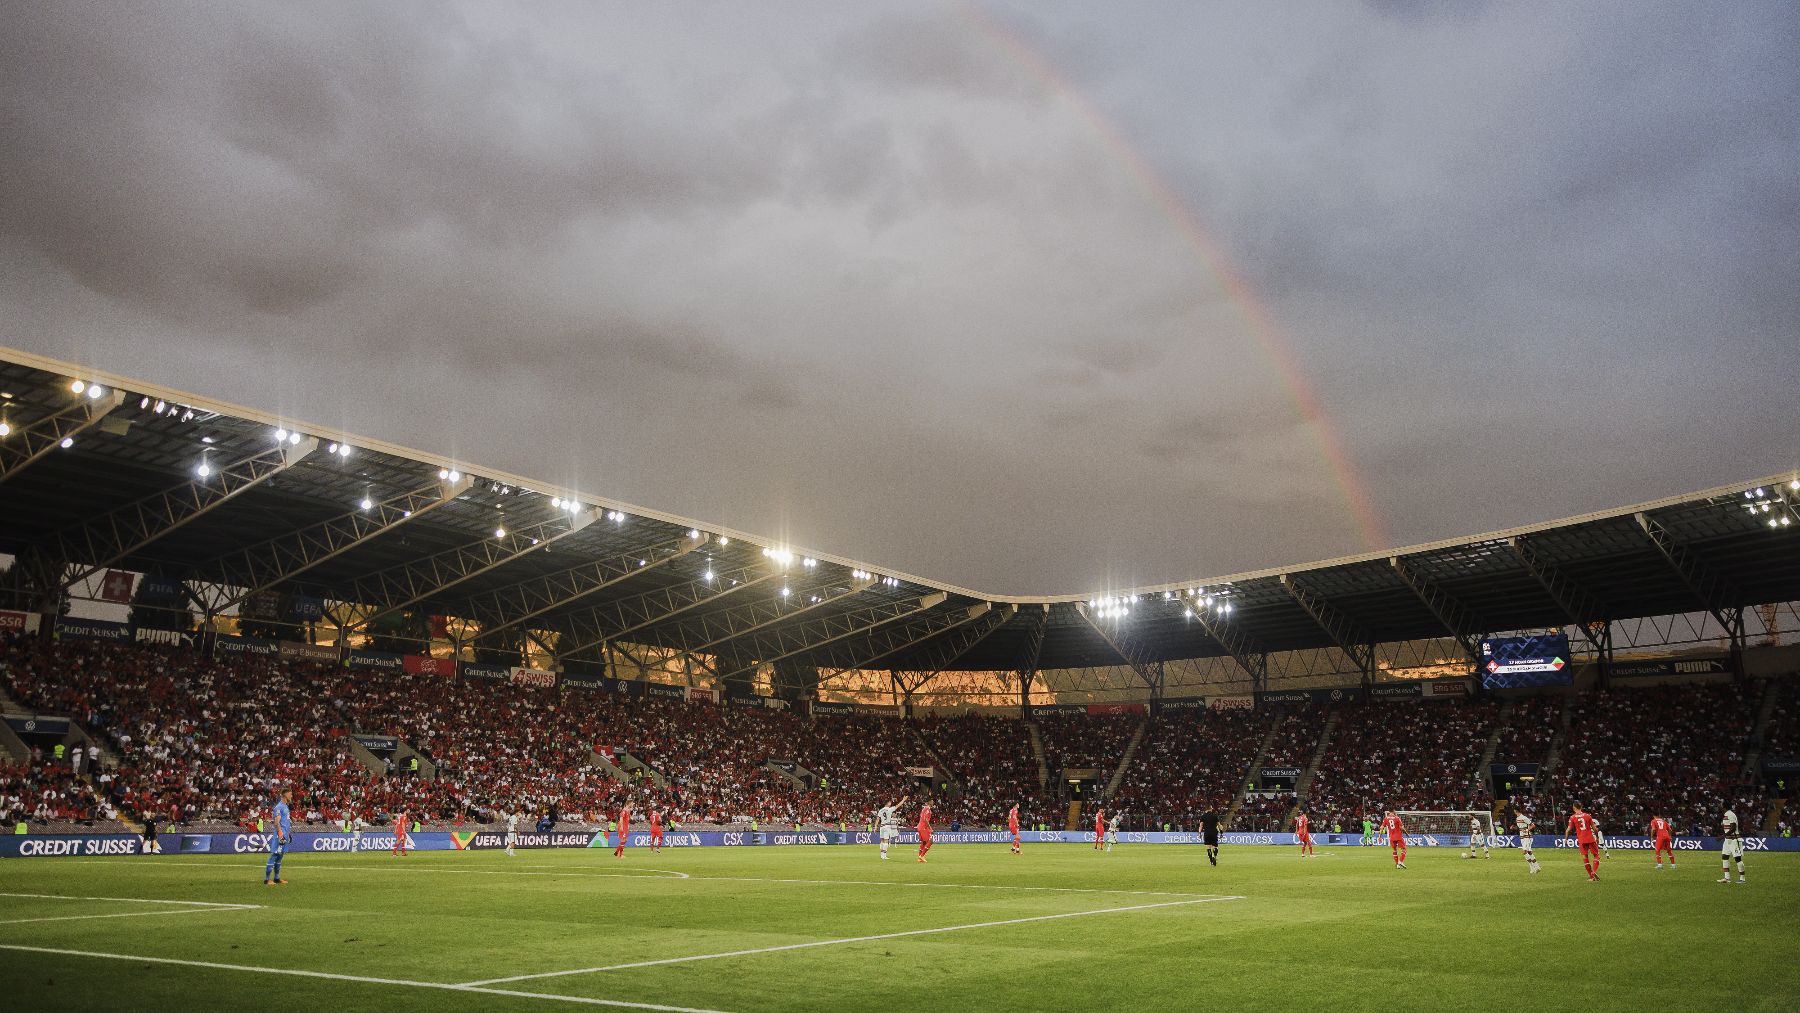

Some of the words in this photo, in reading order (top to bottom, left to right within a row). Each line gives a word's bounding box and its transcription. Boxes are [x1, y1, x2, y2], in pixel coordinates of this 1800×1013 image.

[149, 583, 174, 593] FIFA
[296, 602, 322, 615] UEFA
[57, 624, 90, 636] CREDIT
[91, 627, 120, 639] SUISSE
[1675, 660, 1711, 673] PUMA
[526, 672, 554, 684] SWISS
[1222, 699, 1252, 707] SWISS
[1388, 819, 1396, 830] 8
[1577, 817, 1587, 831] 3
[476, 835, 502, 848] UEFA
[552, 833, 589, 846] LEAGUE
[665, 835, 689, 846] SUISSE
[724, 833, 744, 846] CSX
[774, 834, 797, 845] CREDIT
[798, 834, 818, 845] SUISSE
[856, 832, 872, 844] CSX
[1039, 831, 1063, 841] CSX
[1127, 831, 1150, 842] CSX
[1293, 833, 1317, 845] CX
[19, 839, 82, 856] CREDIT
[85, 839, 136, 855] SUISSE
[234, 834, 274, 853] CSX
[361, 837, 397, 850] SUISSE
[1742, 837, 1769, 851] SX
